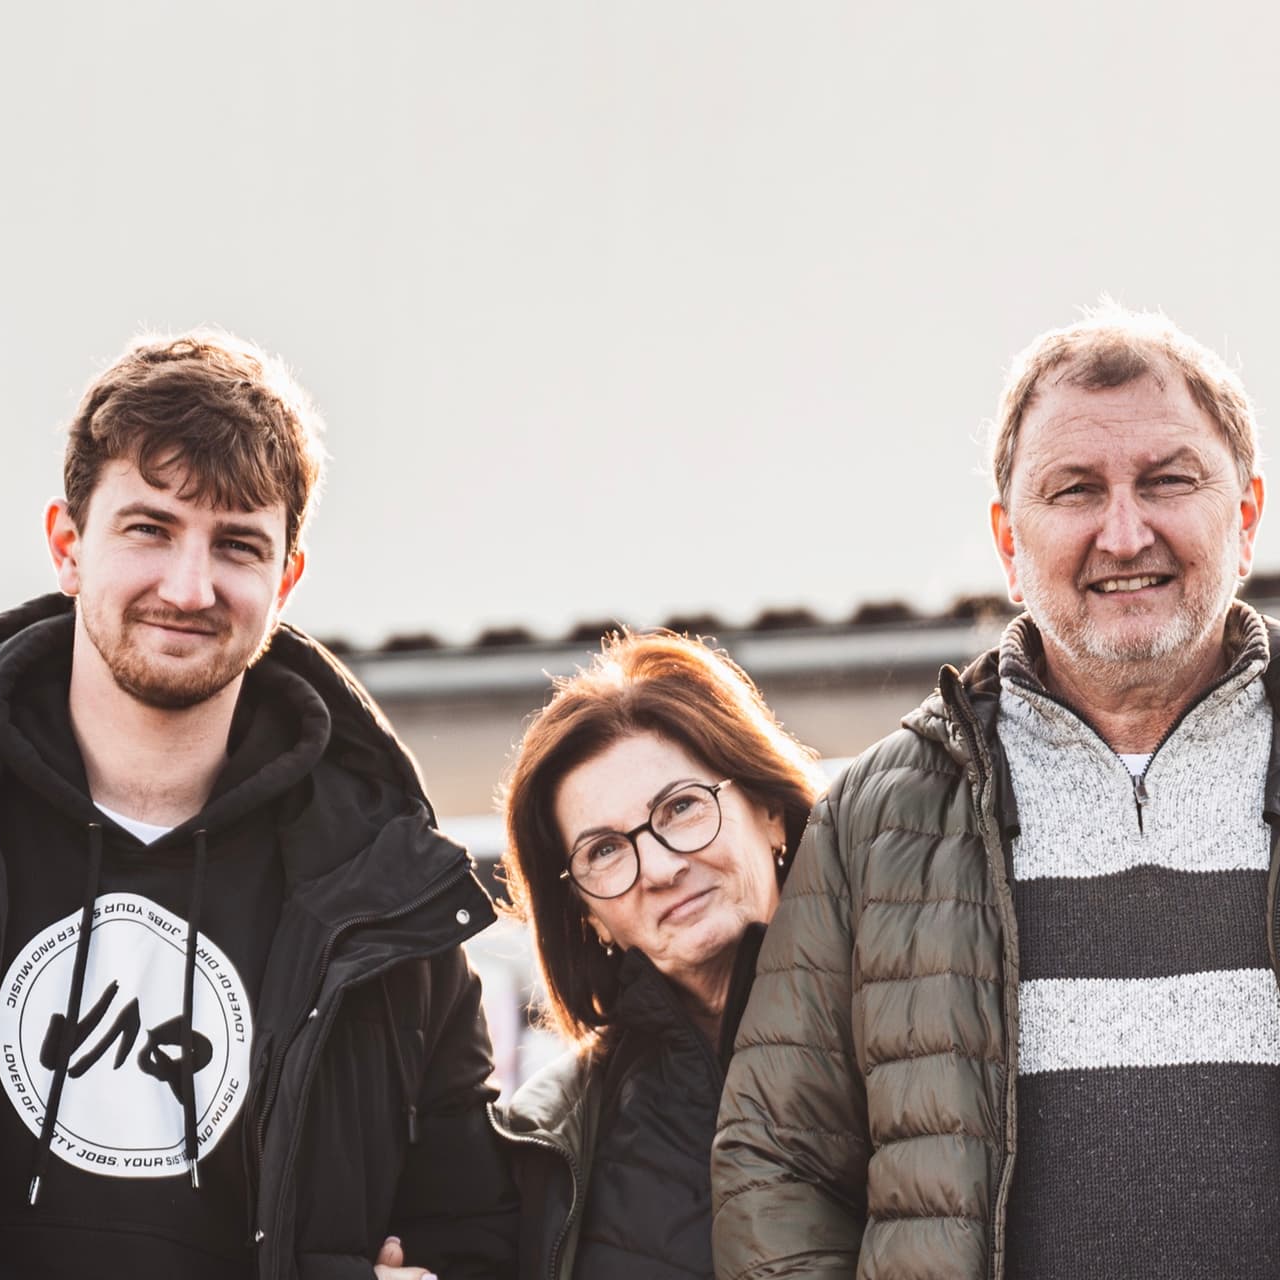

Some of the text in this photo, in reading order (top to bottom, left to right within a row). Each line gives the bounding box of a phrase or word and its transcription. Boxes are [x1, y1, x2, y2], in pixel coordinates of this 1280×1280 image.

[104, 902, 143, 916] YOUR
[31, 938, 56, 964] AND
[6, 961, 34, 1009] MUSIC
[216, 973, 232, 989] OF
[227, 992, 245, 1043] LOVER
[3, 1044, 26, 1093] LOVER
[22, 1096, 38, 1113] OF
[35, 1116, 66, 1151] DTY
[123, 1157, 163, 1167] YOUR
[165, 1149, 189, 1166] SISTE
[196, 1124, 214, 1146] ND
[211, 1078, 239, 1126] MUSIC
